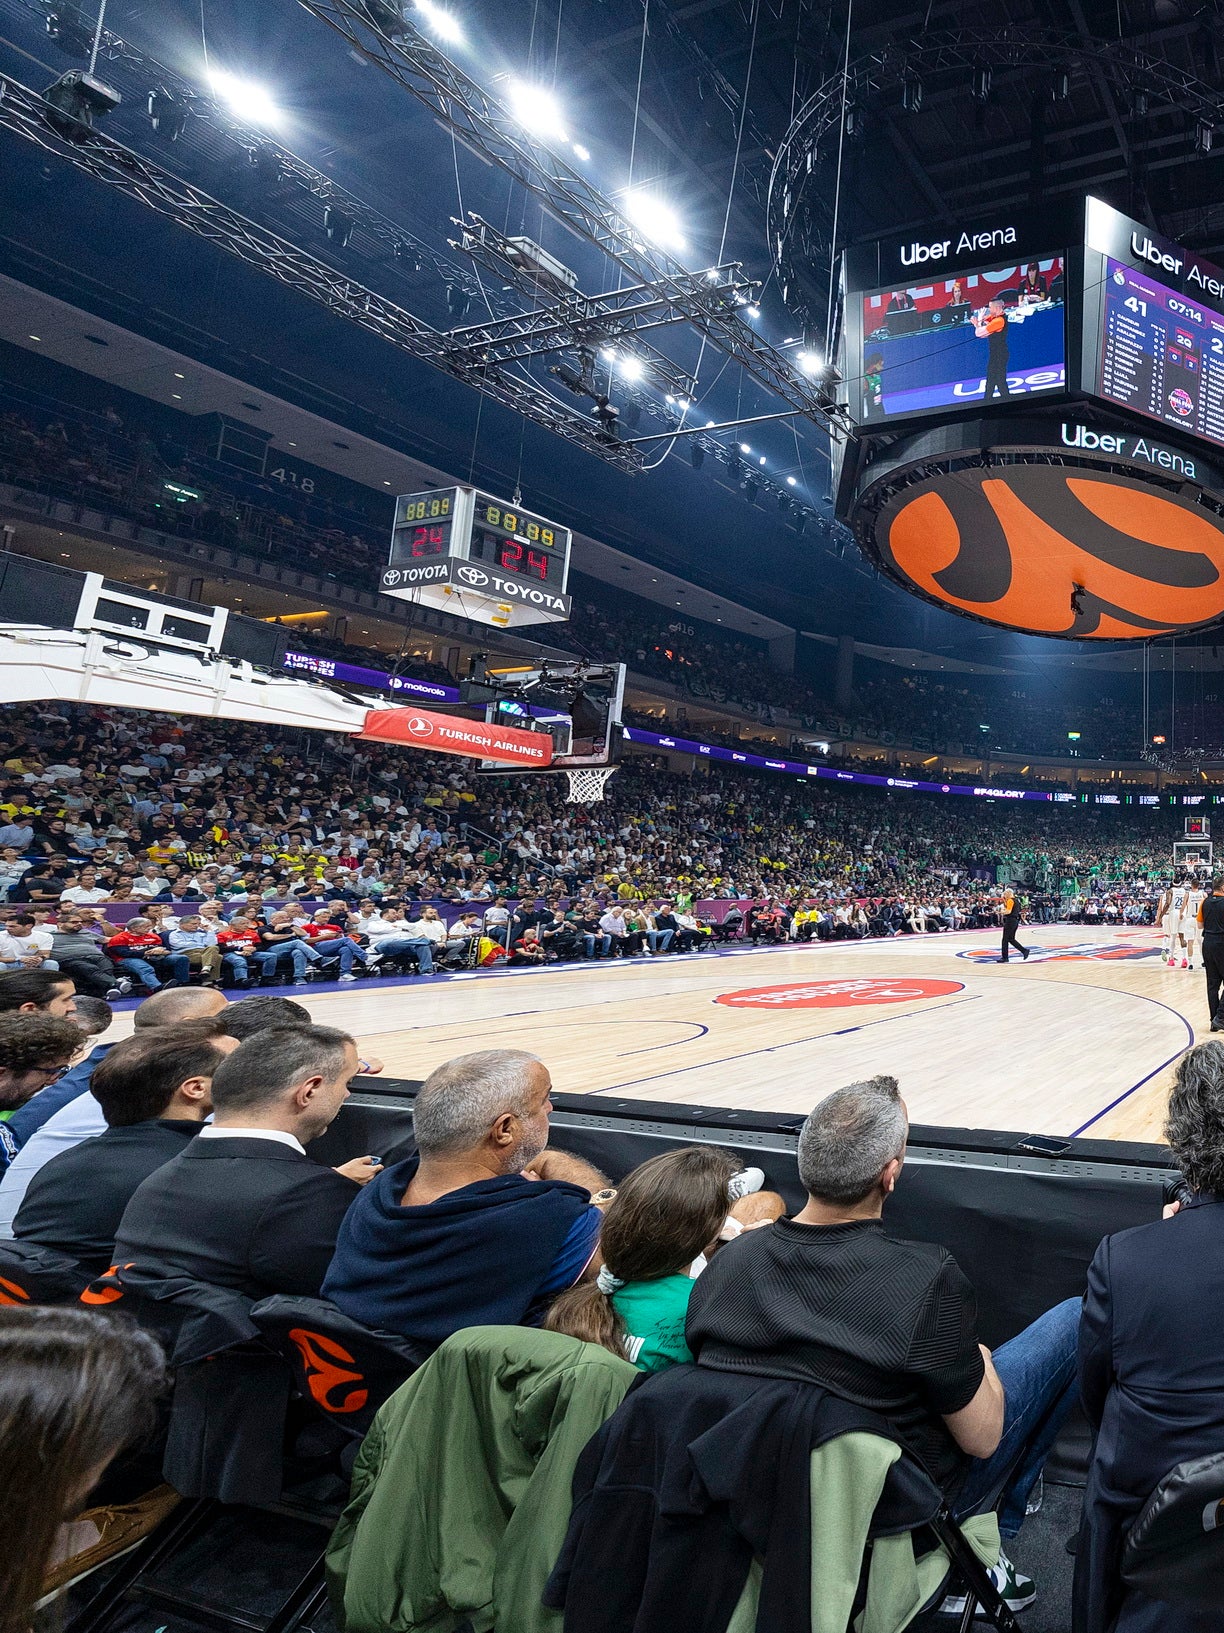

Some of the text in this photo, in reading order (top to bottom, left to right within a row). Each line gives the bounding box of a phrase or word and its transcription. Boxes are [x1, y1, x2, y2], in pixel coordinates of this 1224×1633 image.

[900, 226, 1016, 266] Uber Arena
[1132, 232, 1183, 274] Uber
[1124, 296, 1146, 317] 41
[1168, 299, 1202, 322] 07:14
[1177, 335, 1192, 348] 2Q
[1062, 424, 1196, 478] Uber Arena
[271, 468, 315, 493] 418
[412, 527, 443, 557] 24
[502, 540, 548, 580] 24
[402, 564, 448, 582] TOYOTA
[492, 577, 566, 612] TOYOTA
[284, 652, 336, 670] TURKISH
[403, 682, 446, 697] motorola
[438, 727, 544, 758] TURKISH AIRLINES
[974, 788, 1025, 798] #F4GLORY
